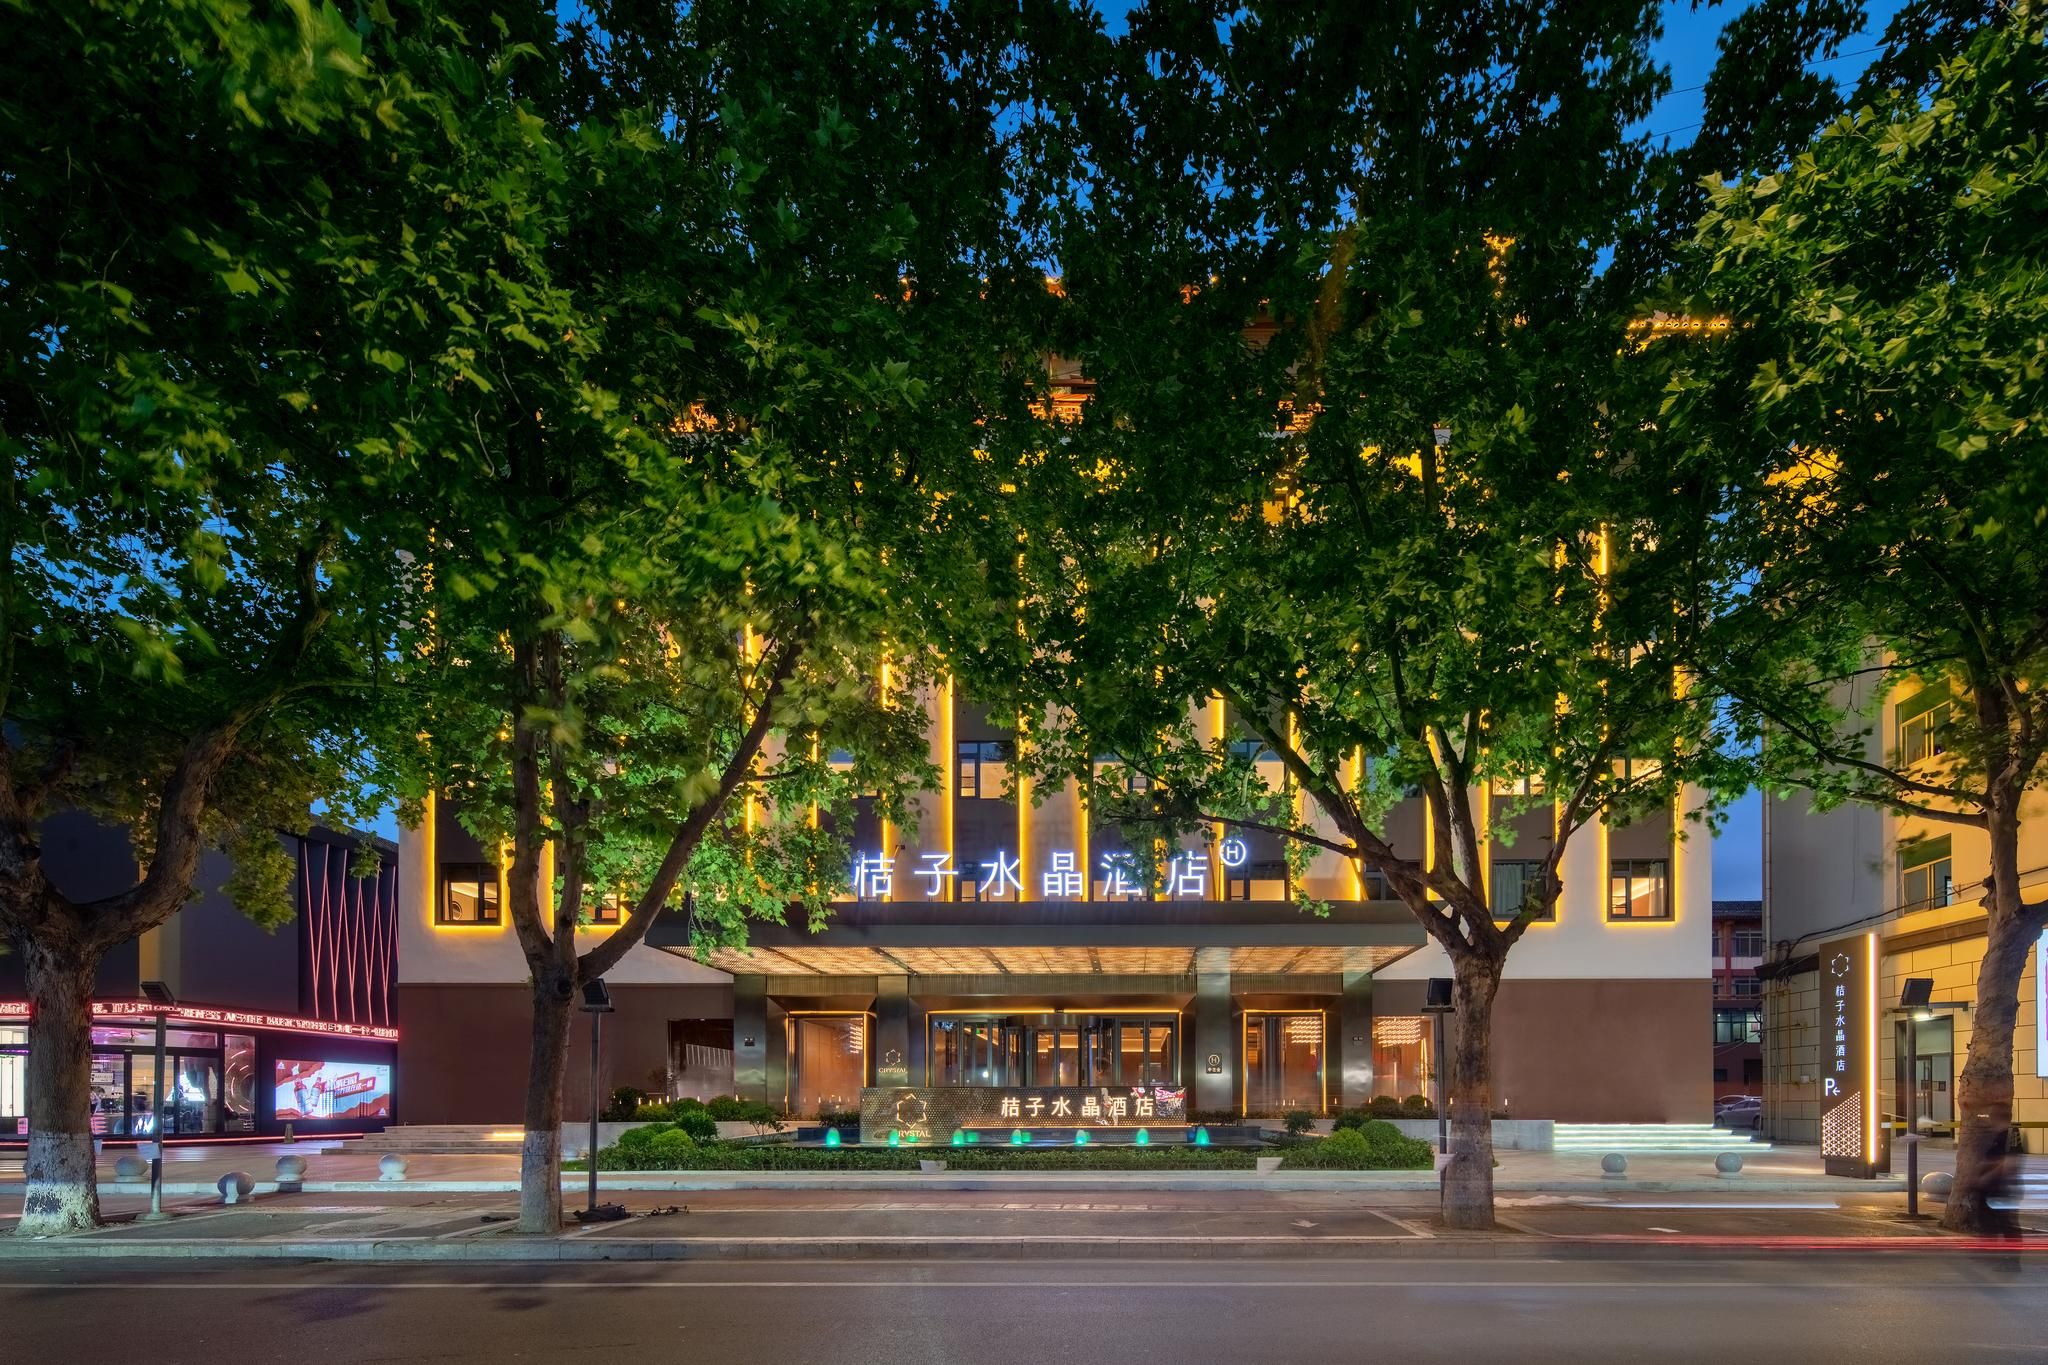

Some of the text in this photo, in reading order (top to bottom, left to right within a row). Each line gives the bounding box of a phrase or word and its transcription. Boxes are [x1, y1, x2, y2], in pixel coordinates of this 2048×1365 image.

[1835, 984, 1846, 1072] 桔子水晶酒店
[1824, 1078, 1835, 1097] P
[1001, 1096, 1154, 1118] 桔子水晶酒店
[898, 1129, 931, 1138] RYSTAL
